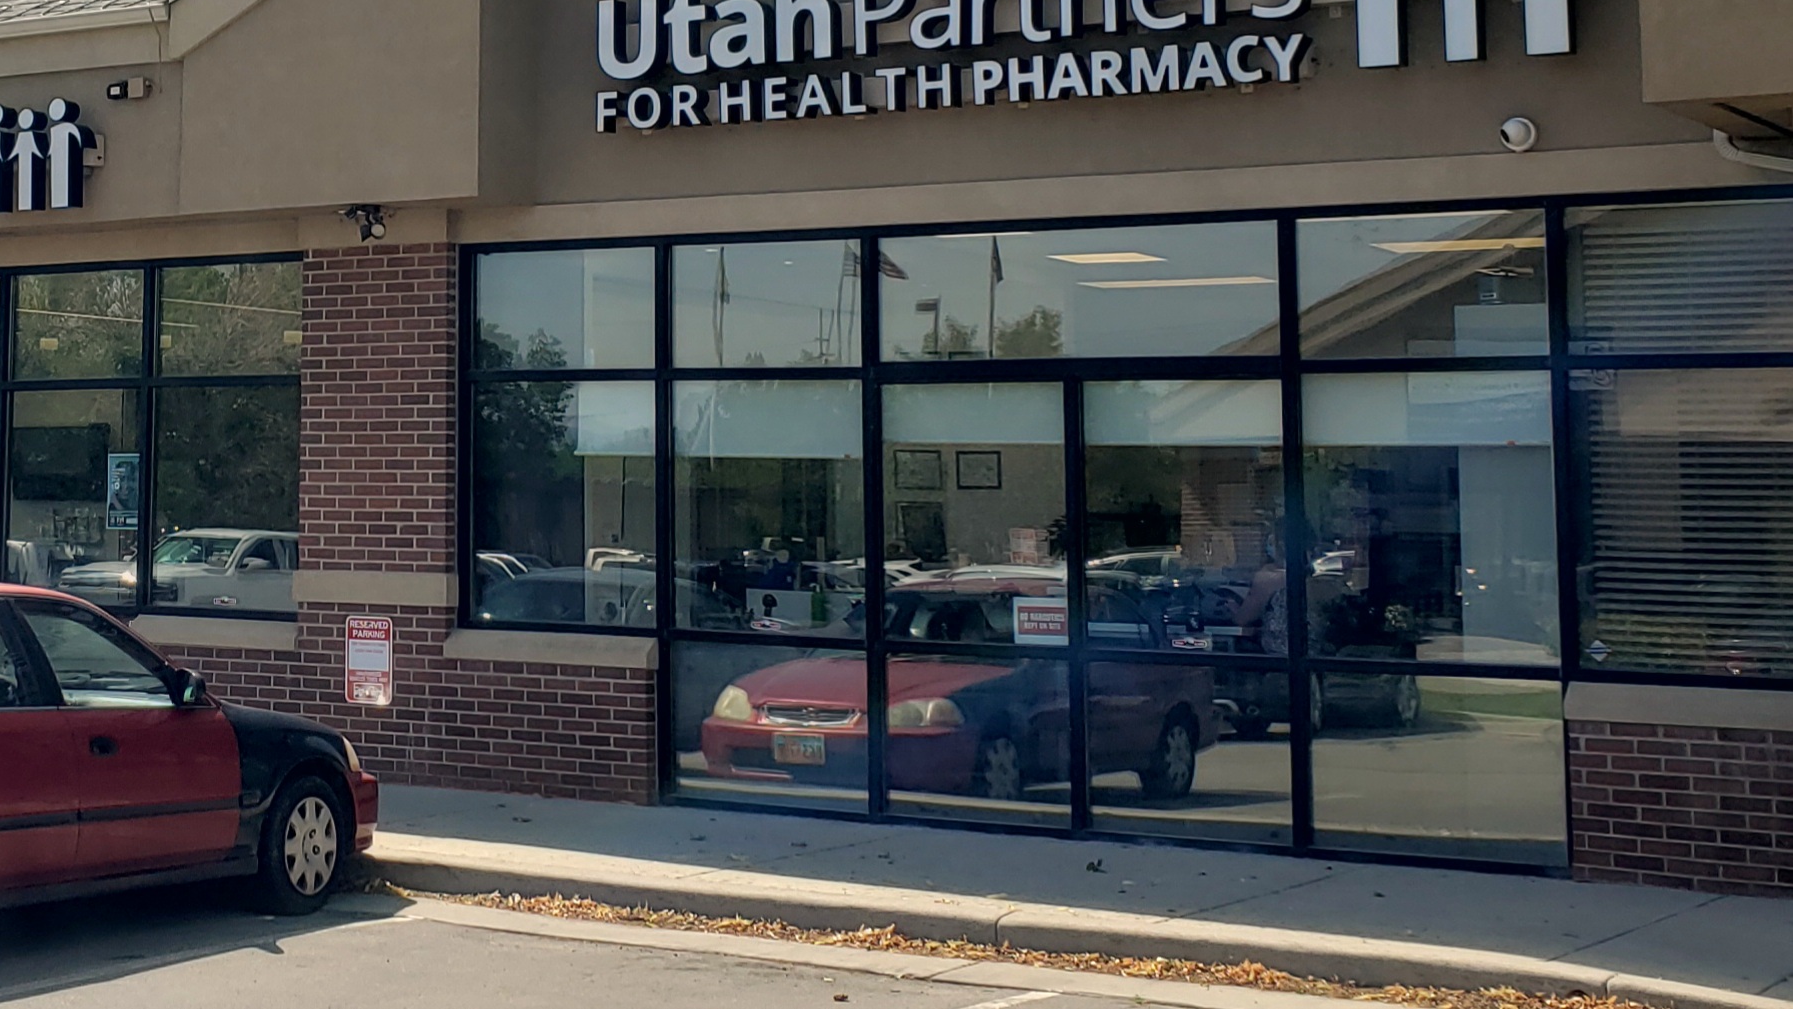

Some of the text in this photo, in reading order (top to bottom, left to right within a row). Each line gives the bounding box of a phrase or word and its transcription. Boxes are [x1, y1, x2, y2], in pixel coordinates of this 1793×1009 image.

[596, 33, 1304, 132] FOR HEALTH PHARMACY
[350, 619, 389, 629] RESERVED
[352, 629, 386, 639] PARKING
